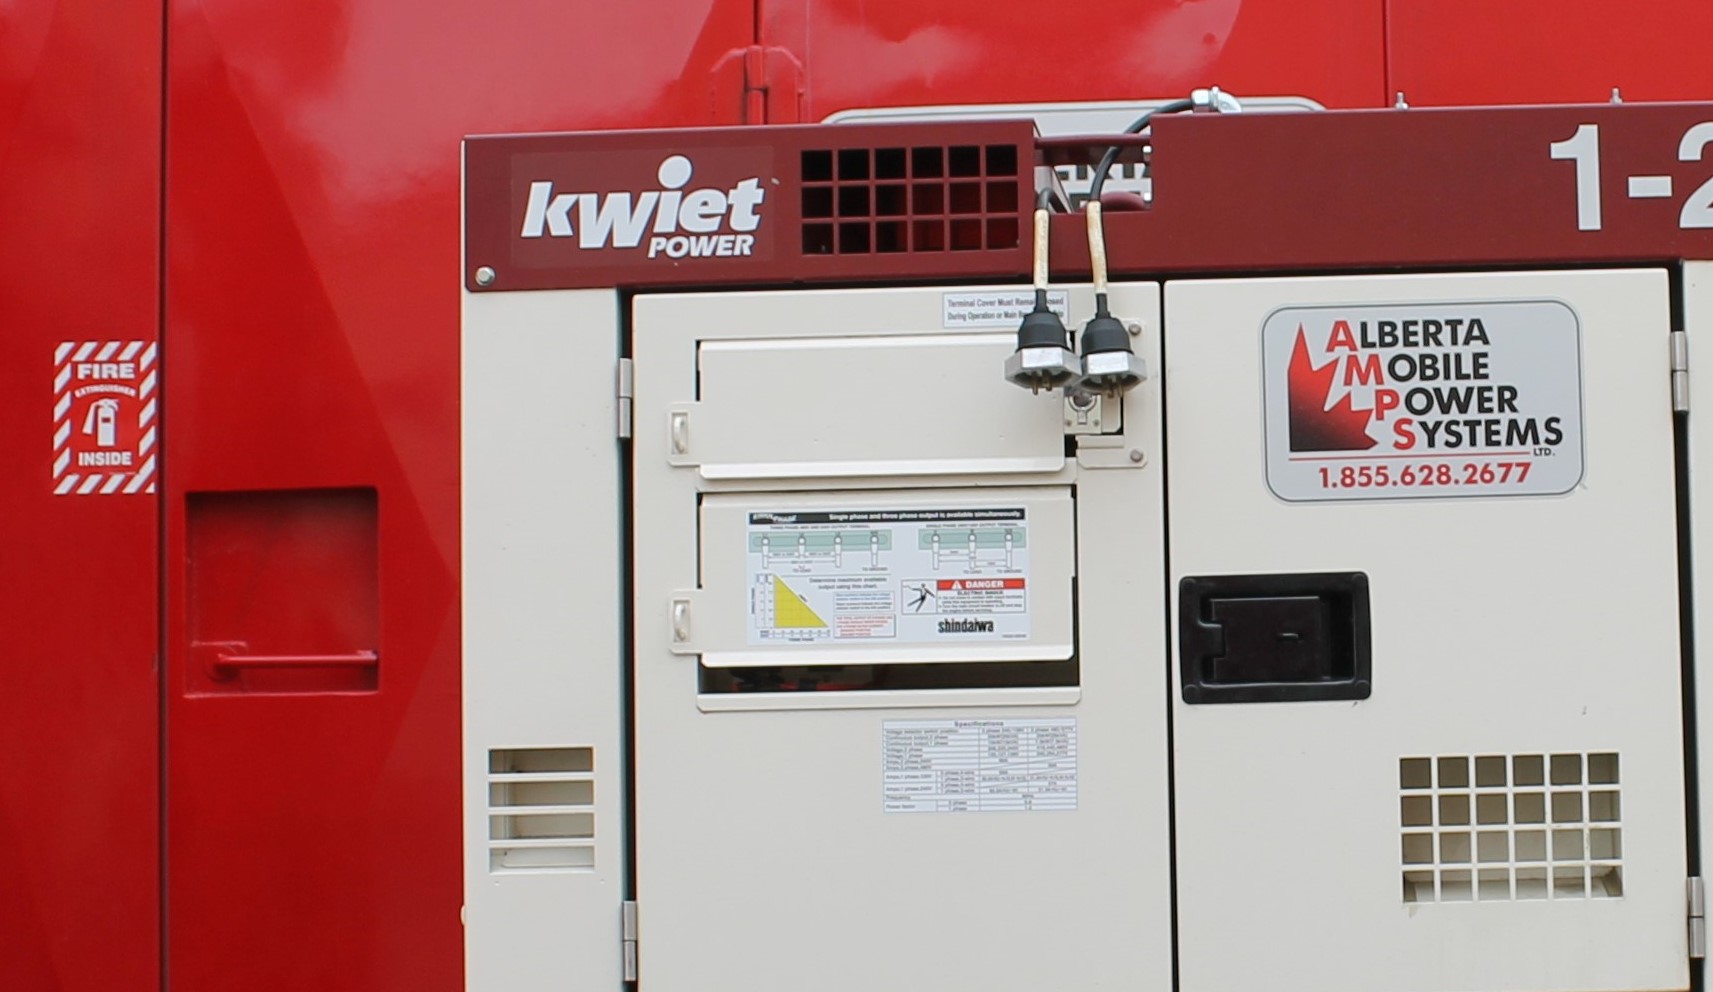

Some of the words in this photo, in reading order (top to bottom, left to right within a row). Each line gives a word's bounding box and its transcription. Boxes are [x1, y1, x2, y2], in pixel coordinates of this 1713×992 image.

[521, 155, 764, 250] kwiet
[647, 234, 754, 260] POWER
[947, 299, 975, 307] Terminal
[998, 298, 1013, 306] Must
[947, 312, 966, 321] During
[968, 311, 995, 320] Operation
[1326, 318, 1490, 353] ALBERTA
[77, 363, 135, 380] FIRE
[1343, 352, 1490, 387] MOBILE
[75, 384, 136, 398] EXTINGUISHER
[1375, 385, 1519, 421] POWER
[1392, 416, 1563, 450] SYSTEMS
[78, 452, 132, 466] INSIDE
[1533, 447, 1555, 456] LTD.
[1318, 461, 1532, 489] 1.855.628.2677
[966, 580, 1004, 588] DANGER
[938, 618, 994, 633] shindaiwa
